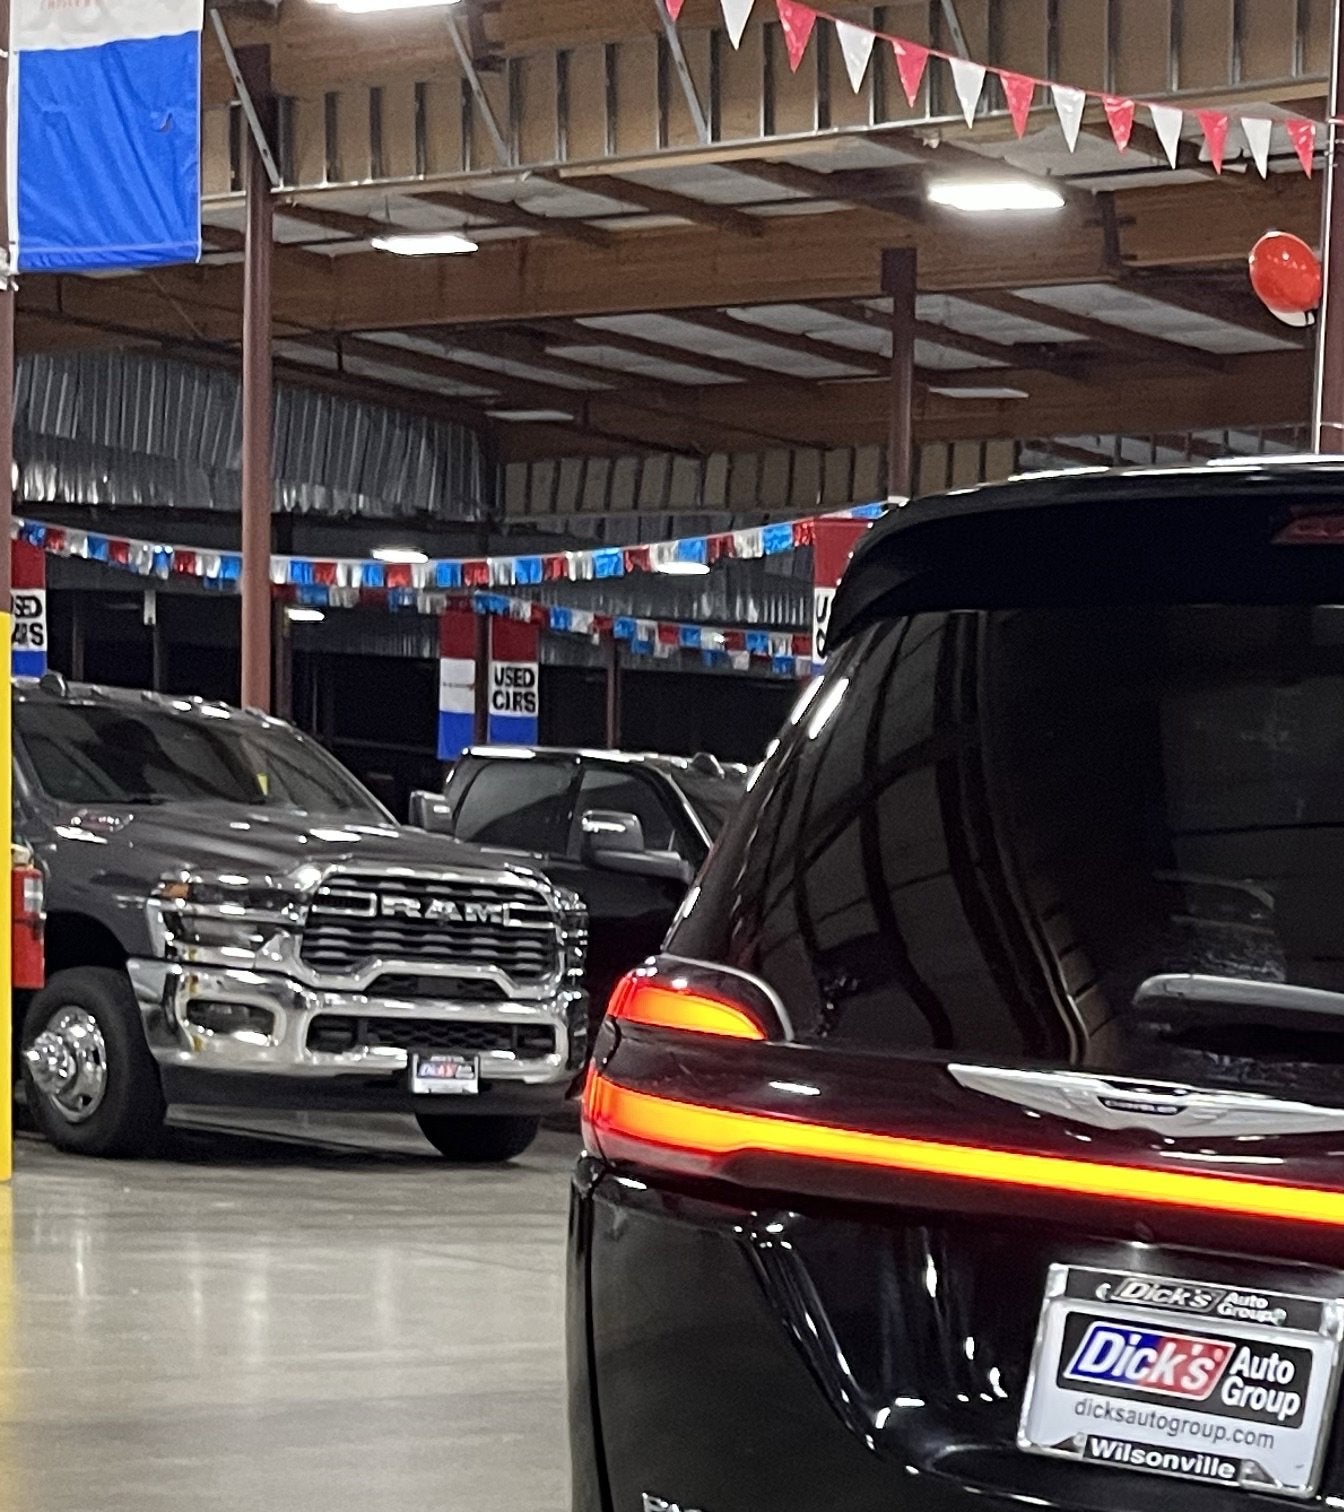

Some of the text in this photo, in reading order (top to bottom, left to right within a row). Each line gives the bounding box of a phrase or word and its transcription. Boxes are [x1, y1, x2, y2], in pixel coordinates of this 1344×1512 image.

[15, 595, 42, 618] SED
[494, 666, 535, 688] USED
[381, 894, 503, 923] RAM
[1120, 1282, 1268, 1309] Dick's Auto
[1077, 1330, 1295, 1391] Dick's Auto
[1220, 1376, 1301, 1421] Group
[1074, 1398, 1274, 1449] dicksautogroup.com
[1090, 1437, 1236, 1479] Wilsonville
